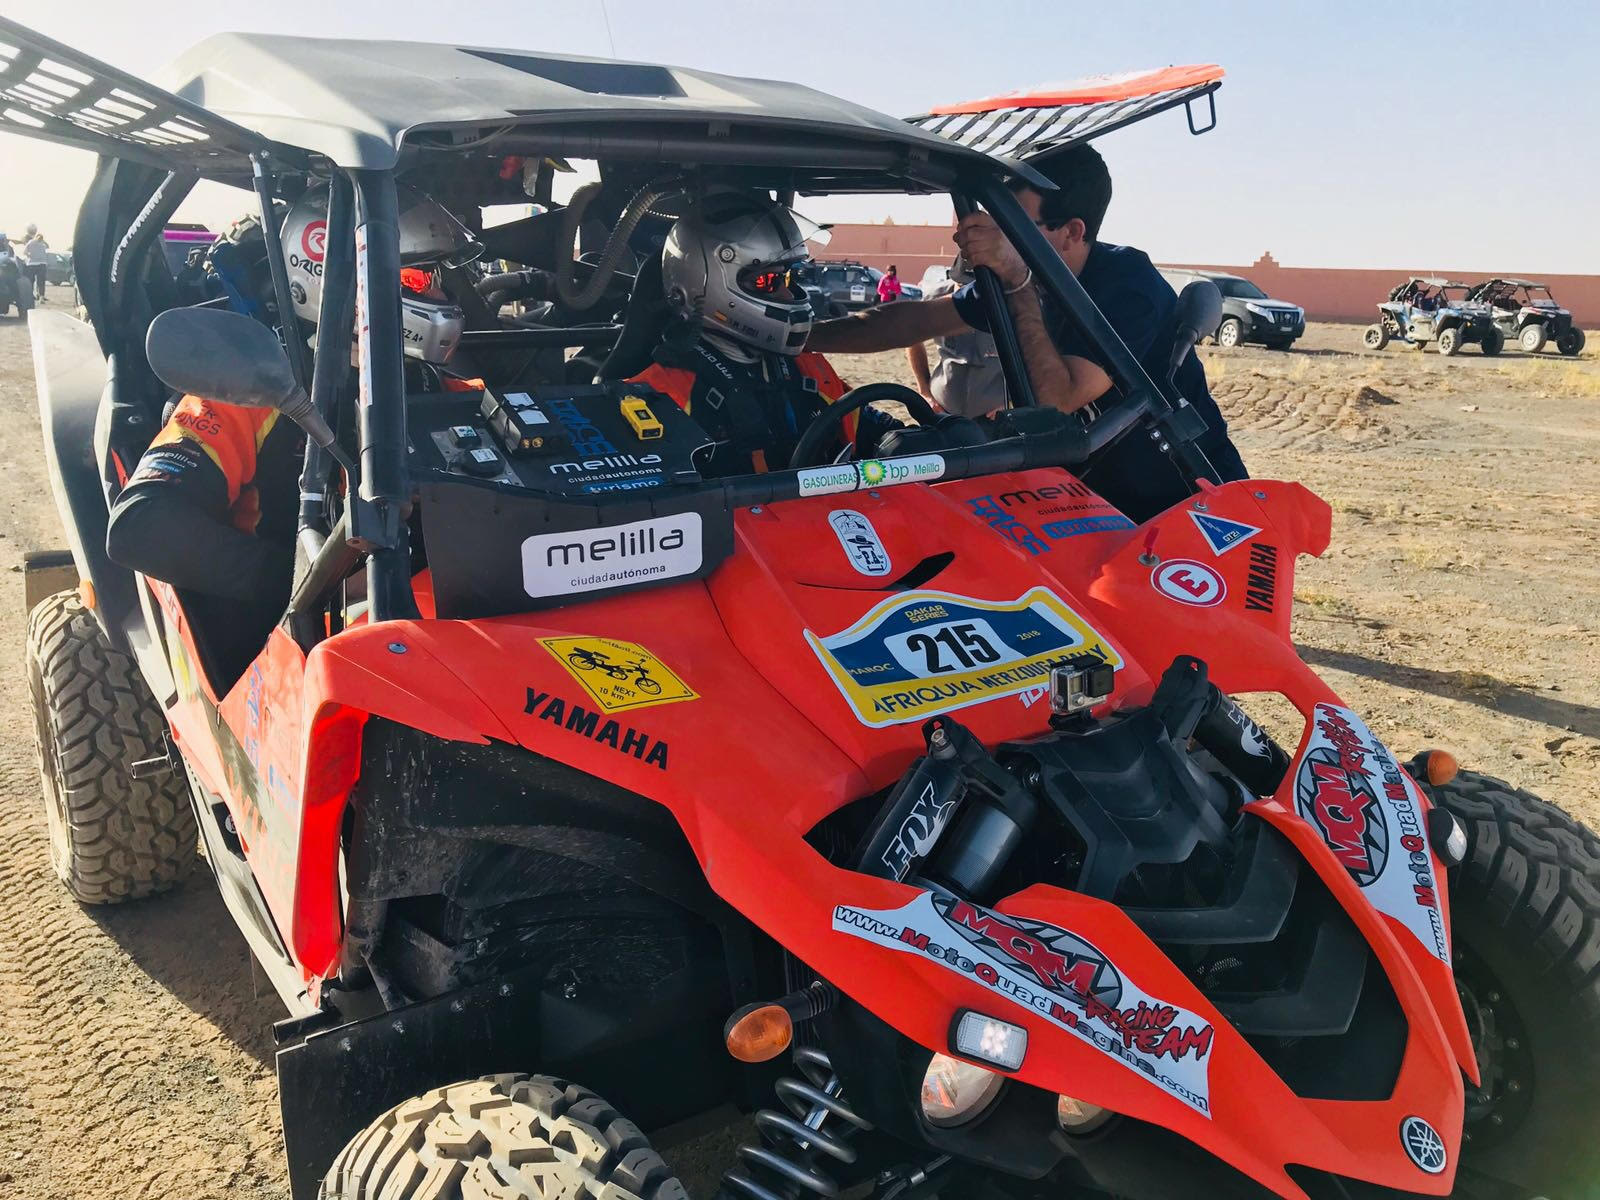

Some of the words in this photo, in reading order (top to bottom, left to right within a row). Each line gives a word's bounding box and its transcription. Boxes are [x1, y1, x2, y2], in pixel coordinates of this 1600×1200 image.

[290, 254, 323, 277] ORIG
[550, 453, 662, 475] melilla
[803, 473, 857, 488] GASOLINERAS
[889, 464, 909, 480] bp
[914, 463, 940, 475] Melilla
[590, 479, 659, 493] turismo
[547, 527, 684, 567] melilla
[570, 564, 666, 587] ciudadautónoma
[1245, 543, 1277, 613] YAMAHA
[905, 605, 945, 618] DAKAR
[909, 612, 949, 623] SERIES
[1017, 630, 1041, 641] 2018
[907, 623, 1001, 674] 215
[848, 663, 894, 675] MAROC
[600, 686, 608, 695] 10
[613, 685, 636, 697] NEXT
[872, 681, 982, 713] AFRIQUIA
[522, 687, 669, 770] YAMAHA
[1313, 761, 1372, 872] MQM
[882, 781, 955, 882] FOX
[950, 900, 1099, 998] MQM
